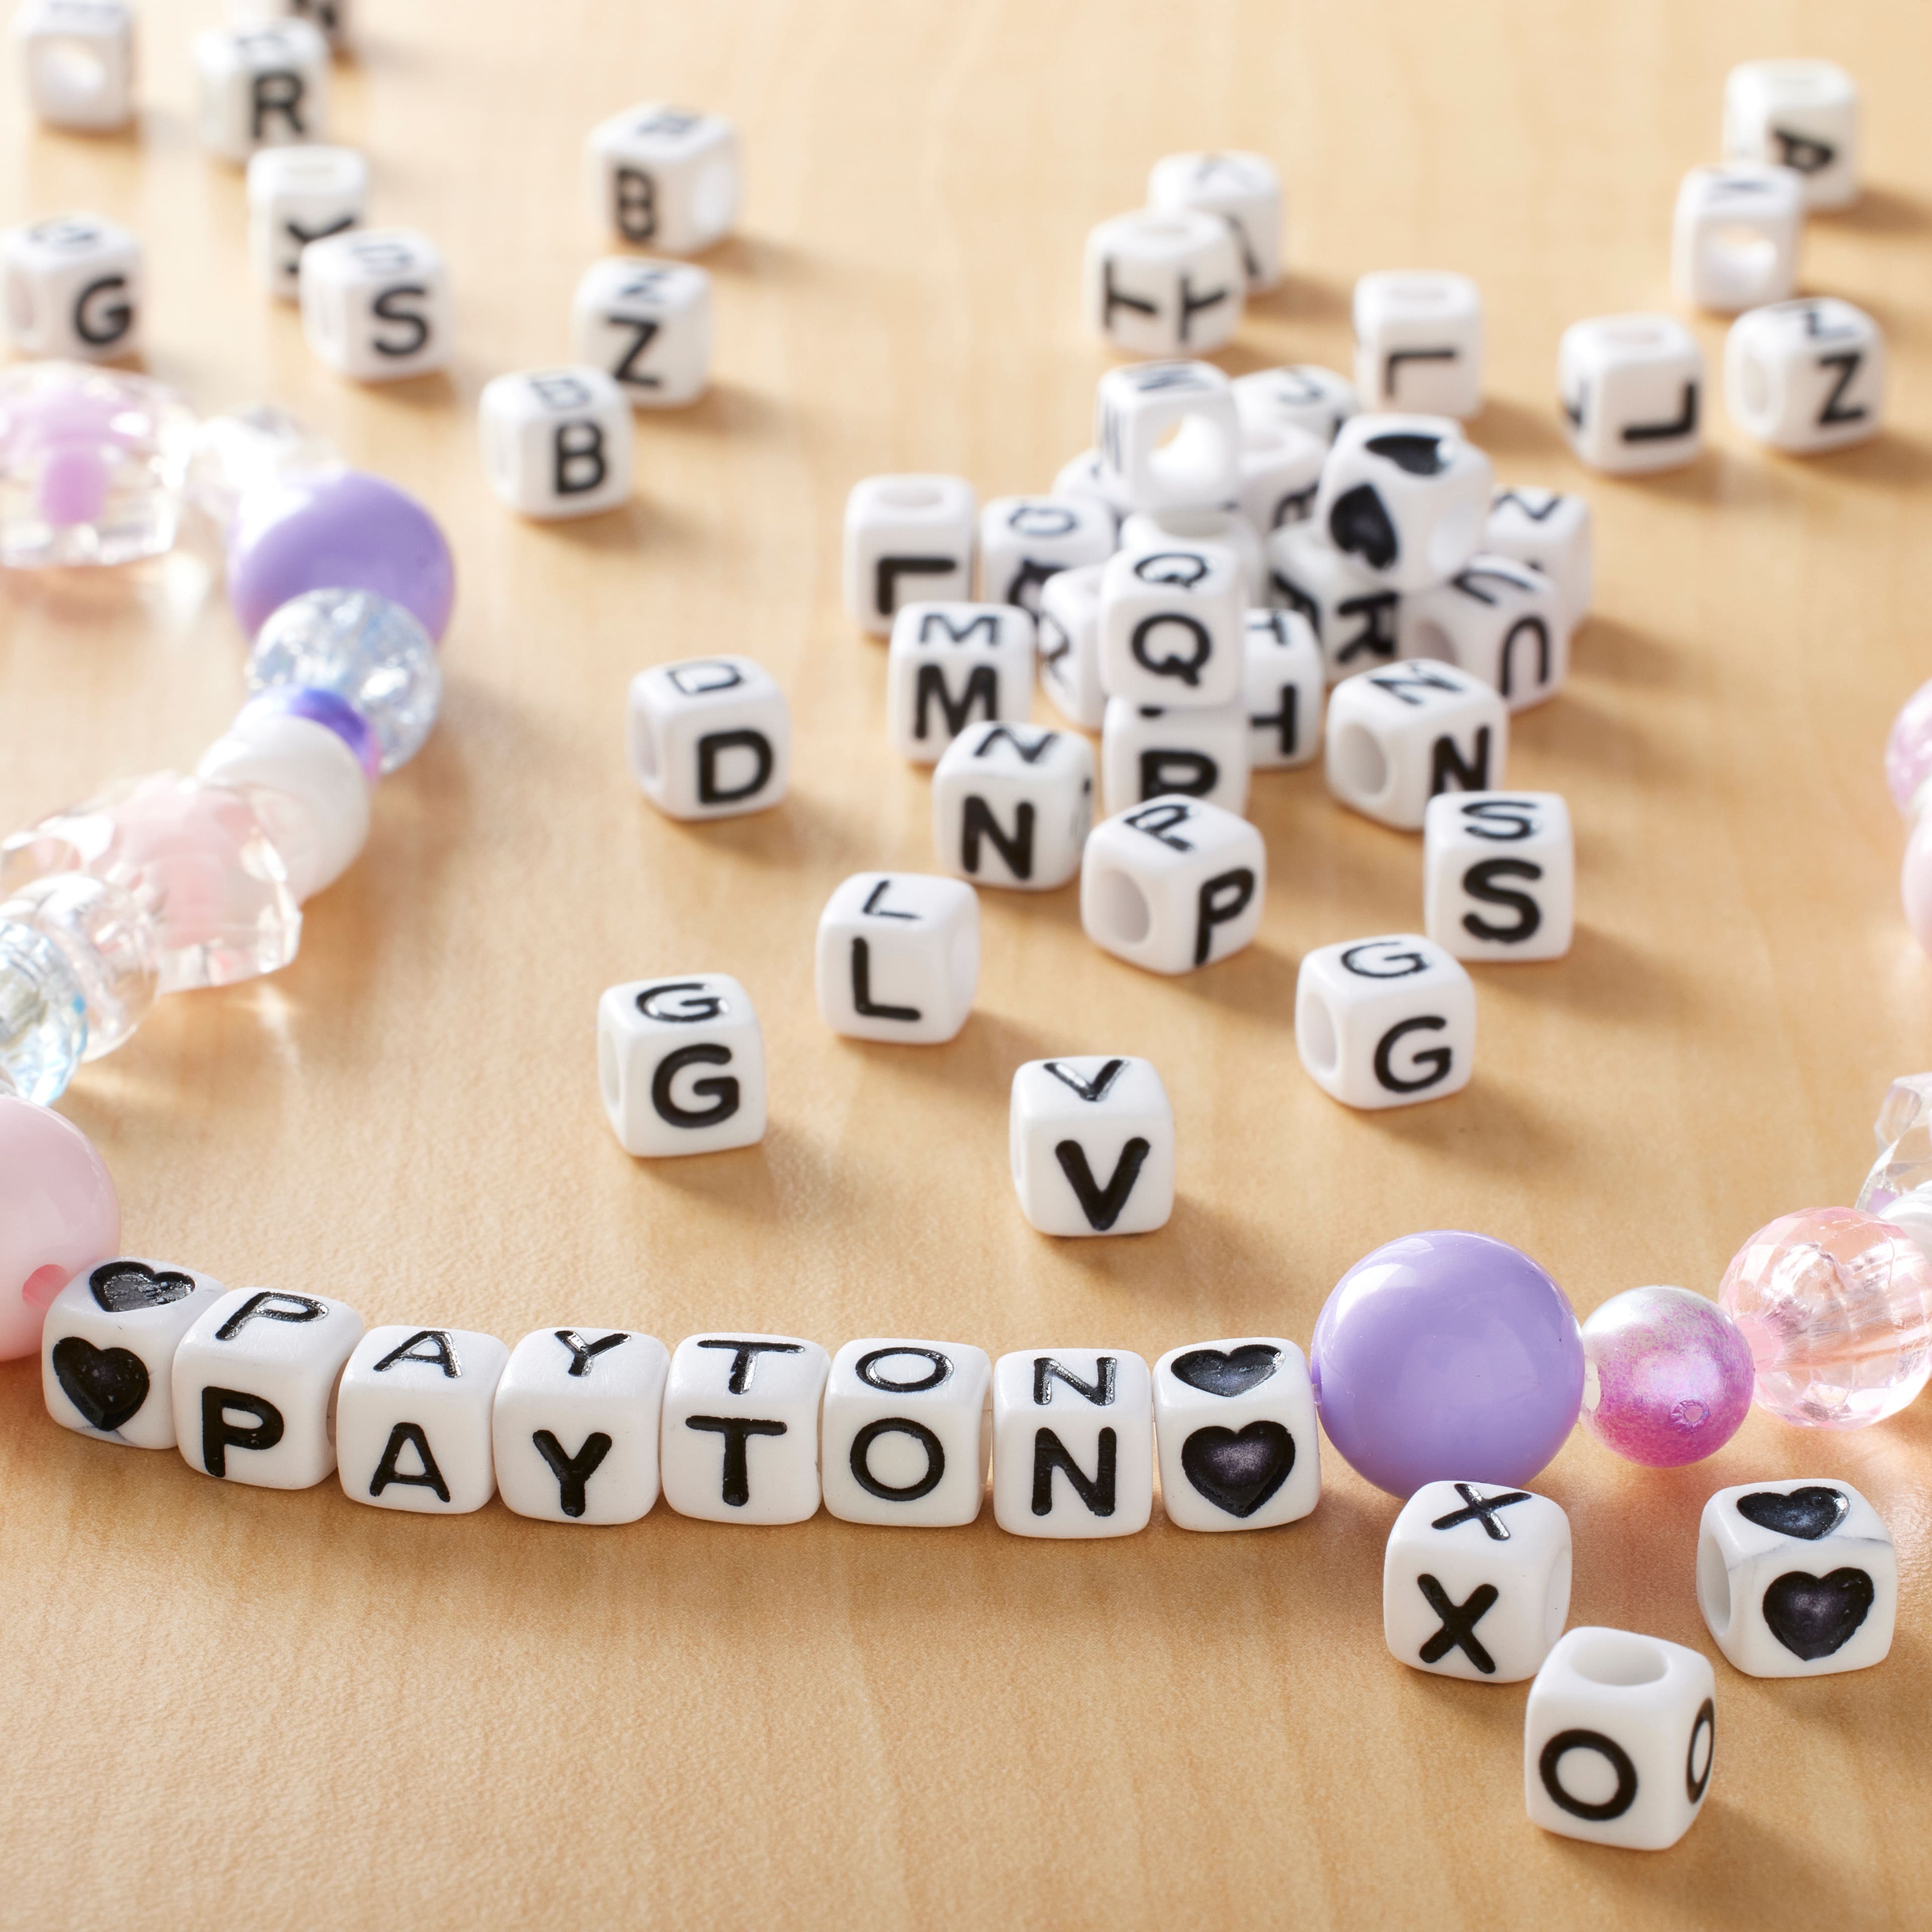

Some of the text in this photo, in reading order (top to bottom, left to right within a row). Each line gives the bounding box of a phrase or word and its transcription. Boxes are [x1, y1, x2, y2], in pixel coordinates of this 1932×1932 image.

[252, 69, 308, 140] R
[615, 166, 657, 244] B
[74, 276, 132, 346] G
[372, 285, 430, 357] S
[606, 314, 661, 387] Z
[1817, 350, 1868, 425] Z
[553, 421, 608, 494] B
[1134, 552, 1209, 588] Q
[919, 614, 1000, 646] M
[1131, 612, 1211, 687] Q
[667, 662, 746, 695] D
[914, 664, 998, 740] M
[696, 729, 774, 804] D
[973, 727, 1059, 764] N
[1430, 726, 1491, 796] N
[961, 794, 1035, 880] N
[1123, 804, 1197, 853] P
[1461, 800, 1540, 841] S
[862, 879, 922, 920] L
[1194, 865, 1255, 967] P
[1462, 857, 1544, 944] S
[851, 936, 921, 1022] L
[1340, 941, 1432, 979] G
[635, 983, 730, 1023] G
[651, 1043, 740, 1129] G
[1043, 1059, 1130, 1102] V
[1374, 1015, 1452, 1093] G
[1055, 1136, 1151, 1231] V
[215, 1290, 1118, 1407] PAYTON
[201, 1385, 1117, 1517] PAYTON
[1430, 1482, 1533, 1541] X
[1417, 1573, 1499, 1674] X
[1539, 1728, 1638, 1821] O
[1686, 1697, 1714, 1804] O
